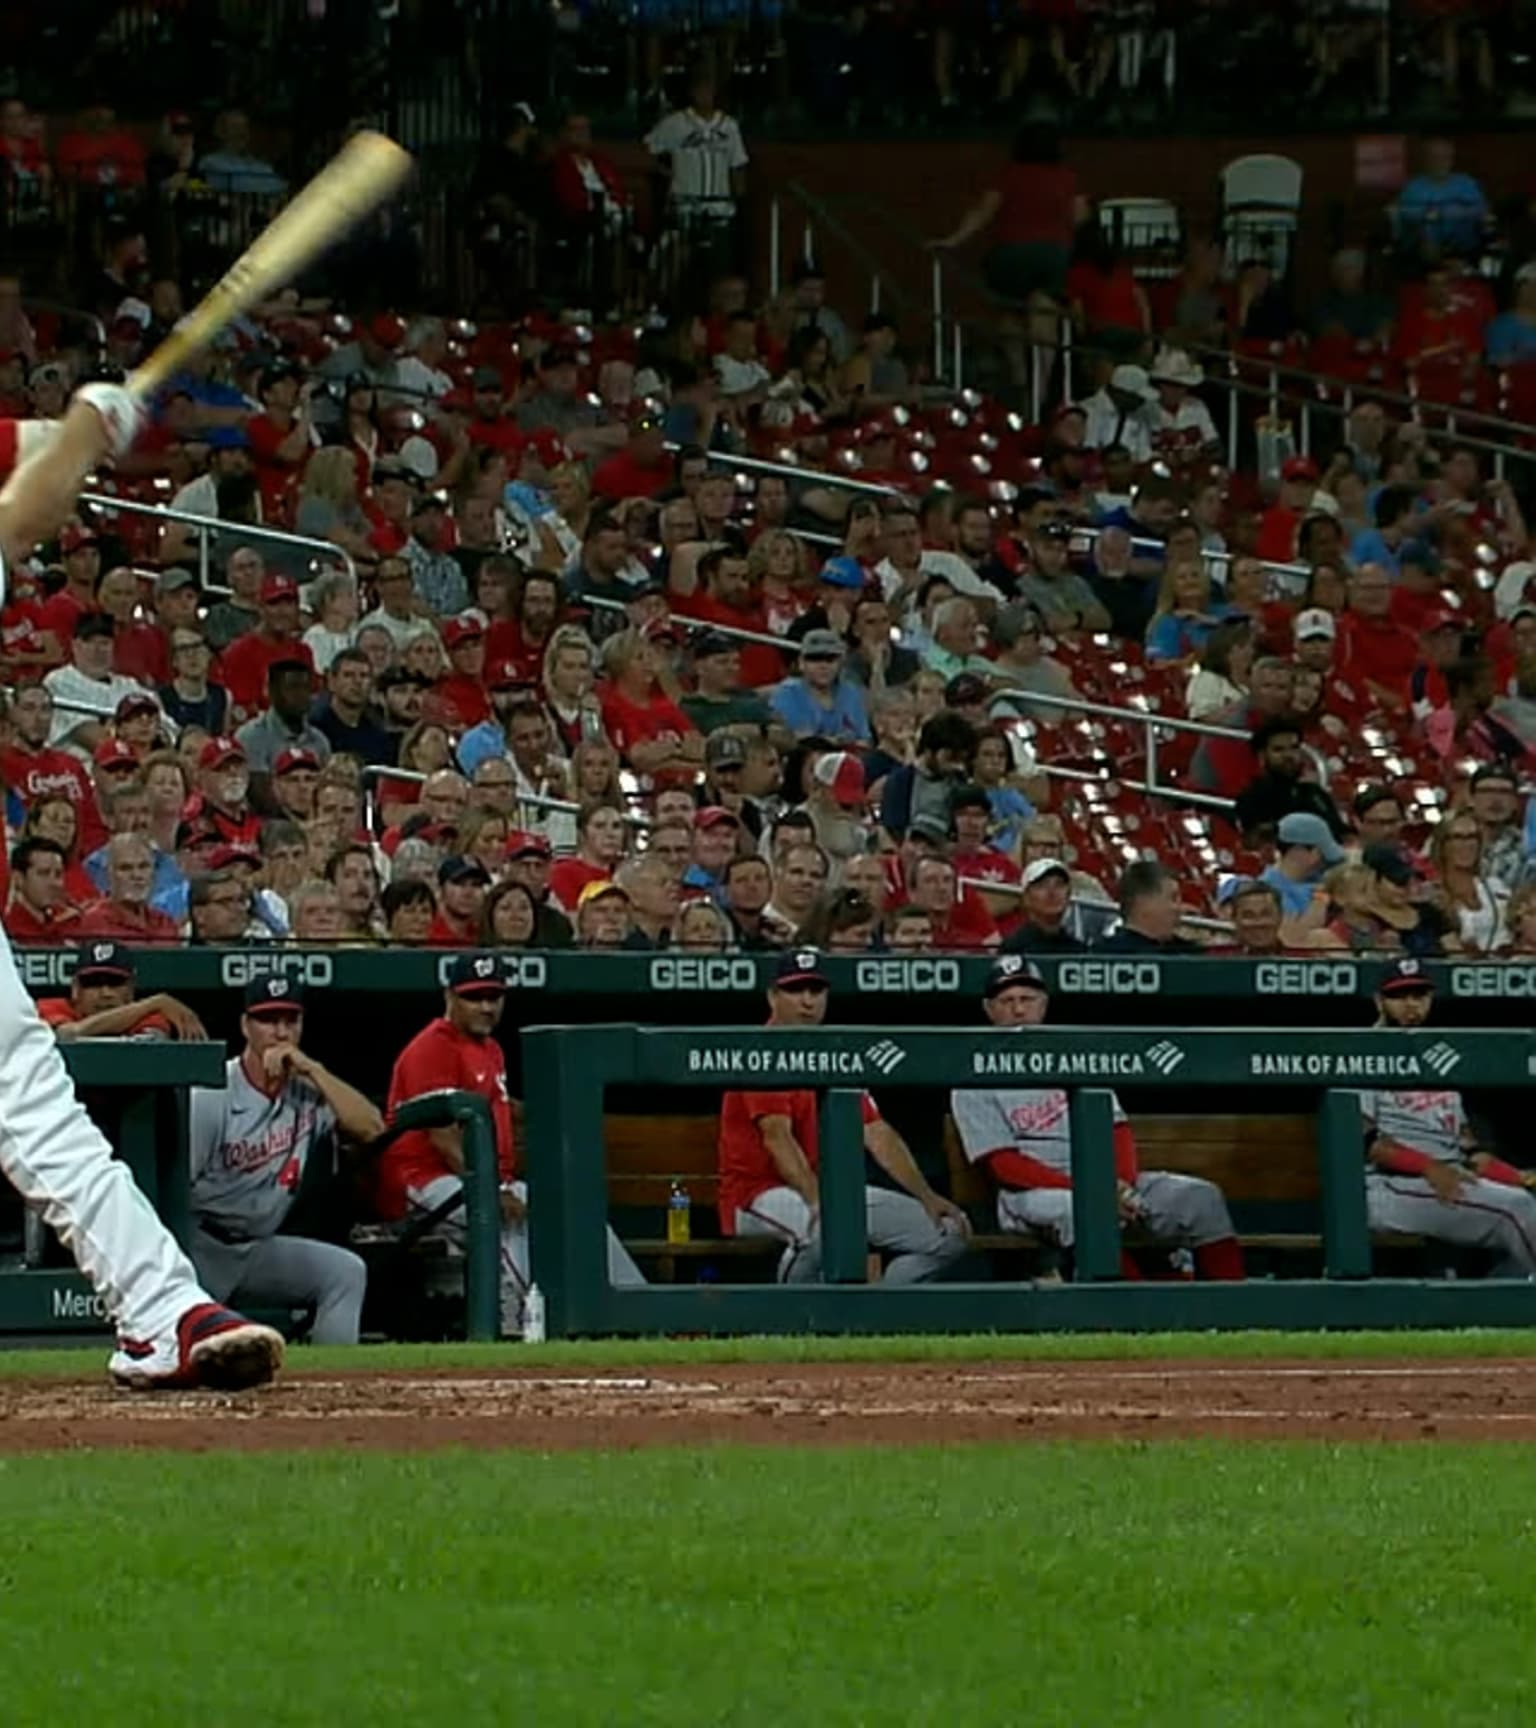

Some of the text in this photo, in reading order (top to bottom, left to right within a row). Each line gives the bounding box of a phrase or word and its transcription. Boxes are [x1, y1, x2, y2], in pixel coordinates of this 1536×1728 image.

[14, 953, 79, 985] EIC
[650, 959, 756, 990] GEICO
[856, 961, 960, 992] GEICO
[1058, 963, 1160, 993] GEICO
[1255, 964, 1357, 994] GEICO
[689, 1050, 864, 1073] BANK OF AMERICA
[973, 1053, 1144, 1074] BANK OF AMERICA
[1251, 1055, 1421, 1075] BANK OF AMERICA
[53, 1288, 109, 1322] Merc
